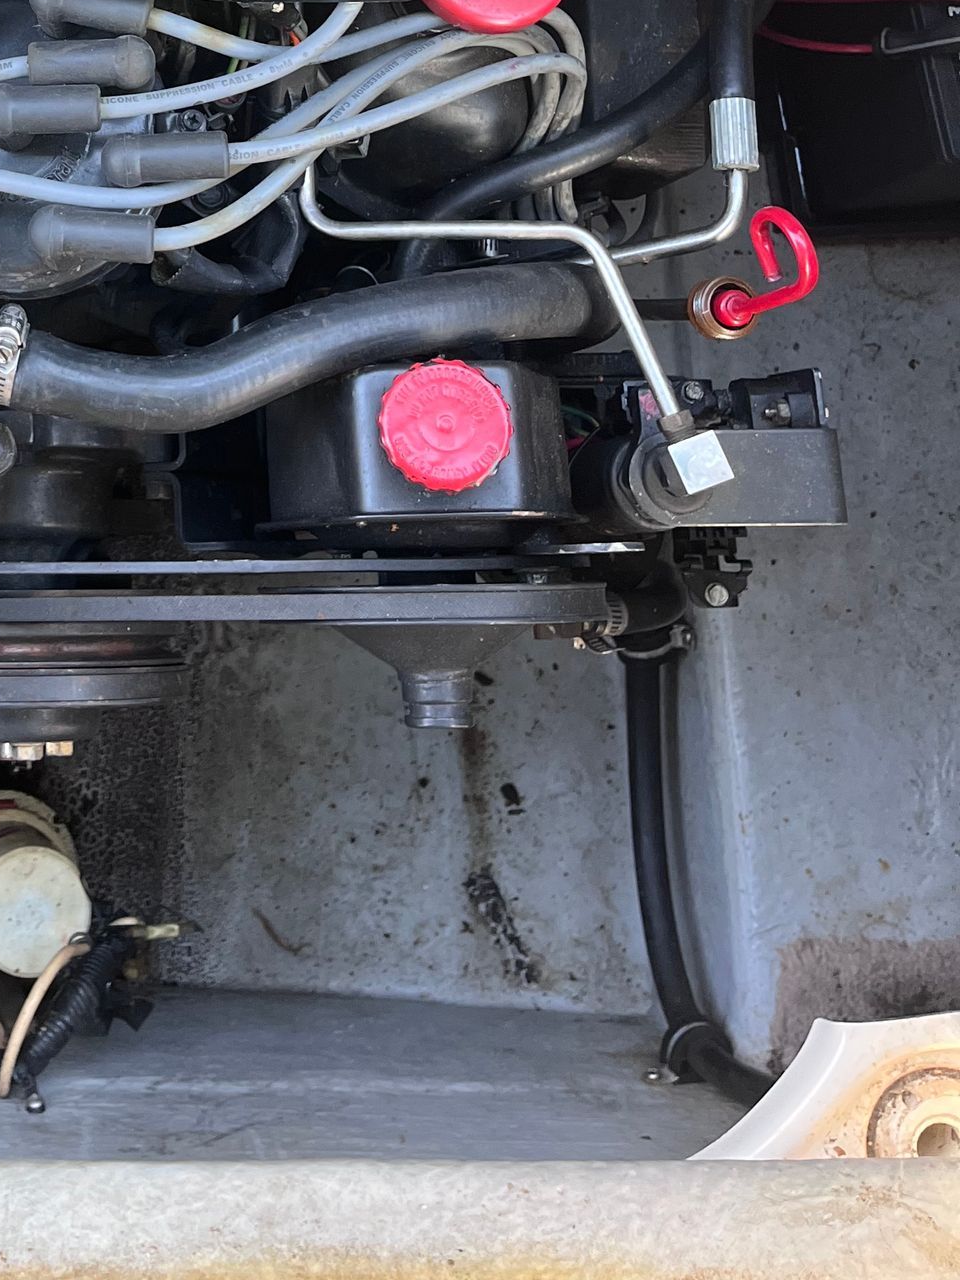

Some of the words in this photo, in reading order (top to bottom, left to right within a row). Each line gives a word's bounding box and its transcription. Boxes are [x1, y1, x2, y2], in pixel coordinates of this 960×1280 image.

[146, 82, 215, 100] SUPPRESSION
[221, 72, 254, 88] CABLE
[352, 60, 400, 101] SUPPRESSION
